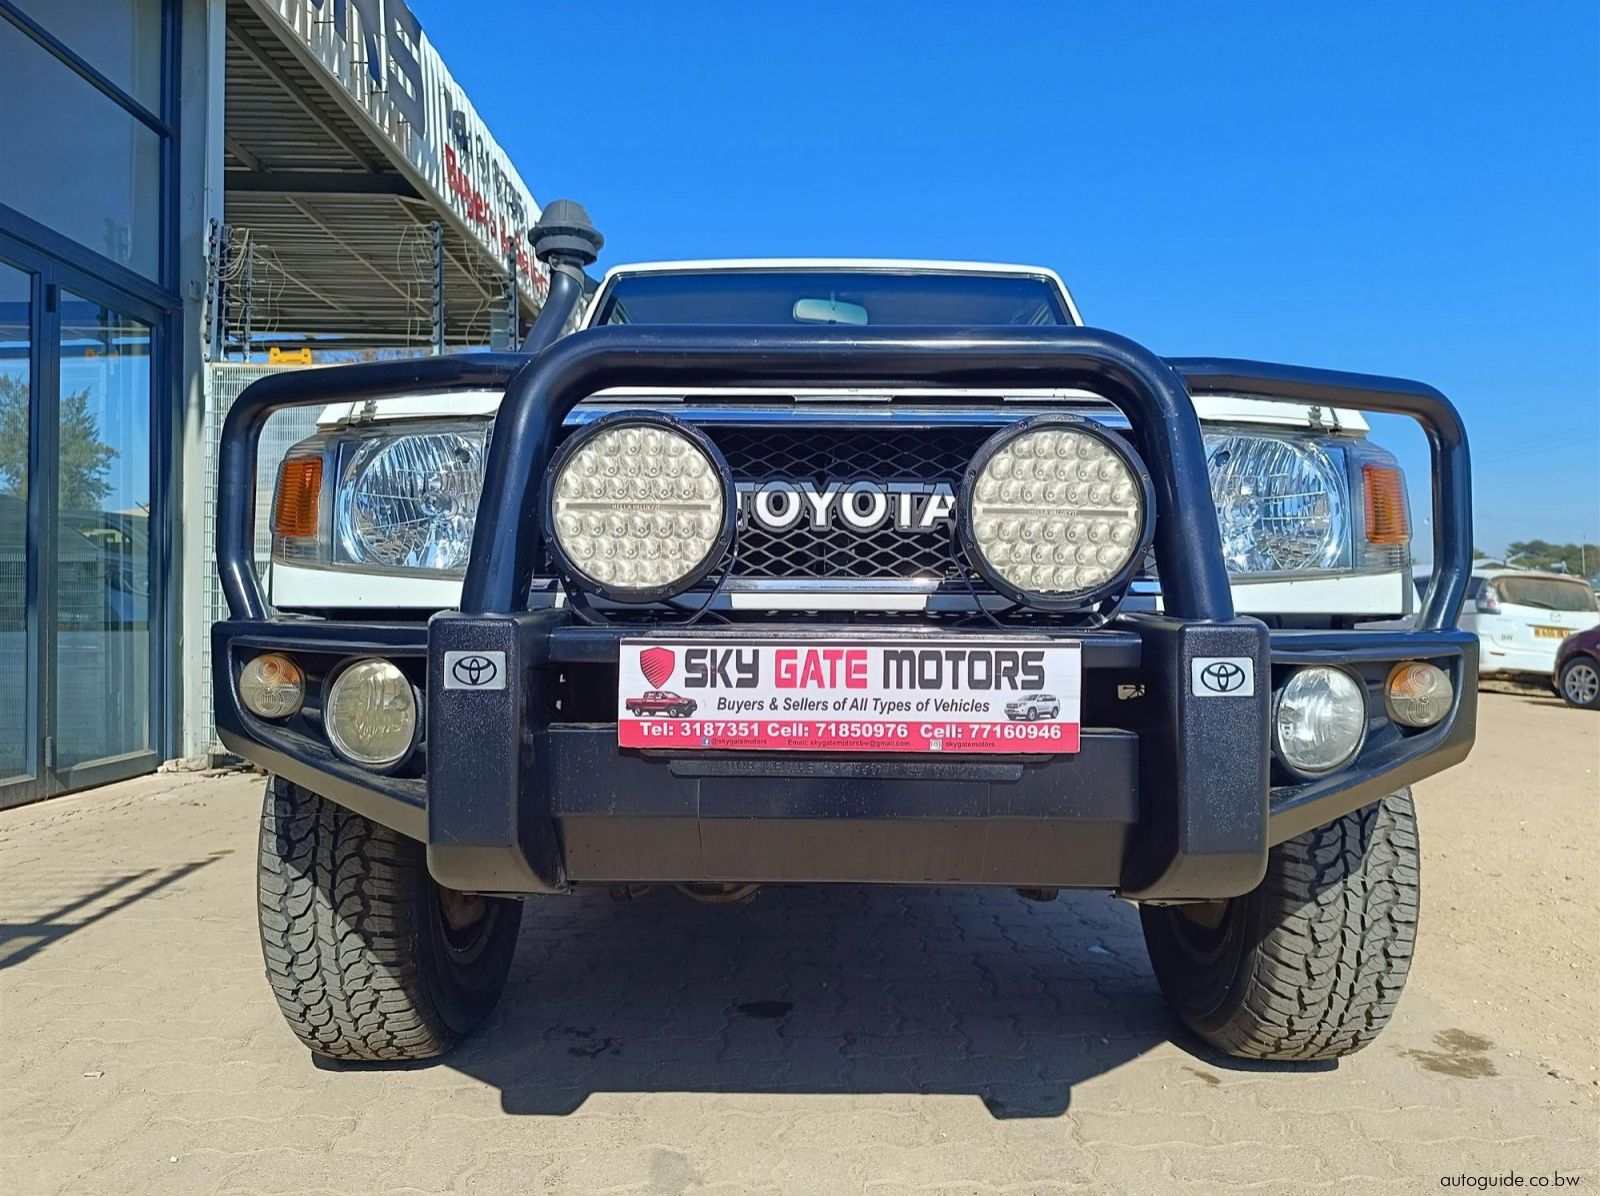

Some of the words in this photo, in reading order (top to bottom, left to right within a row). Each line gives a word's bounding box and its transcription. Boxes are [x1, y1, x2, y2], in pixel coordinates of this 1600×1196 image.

[684, 649, 760, 689] SKY
[774, 649, 868, 689] GATE
[883, 649, 1045, 690] MOTORS
[717, 697, 764, 713] Buyers
[769, 698, 779, 711] &
[783, 698, 828, 711] Sellers
[832, 698, 848, 711] of
[849, 698, 868, 711] All
[872, 698, 911, 715] Types
[916, 699, 930, 712] of
[933, 699, 990, 712] Vehicles
[640, 722, 674, 737] Tel:
[680, 722, 760, 737] 3187351
[767, 723, 809, 737] Cell:
[815, 723, 909, 738] 71850976
[920, 725, 963, 739] Cell:
[969, 725, 1062, 740] 77160946
